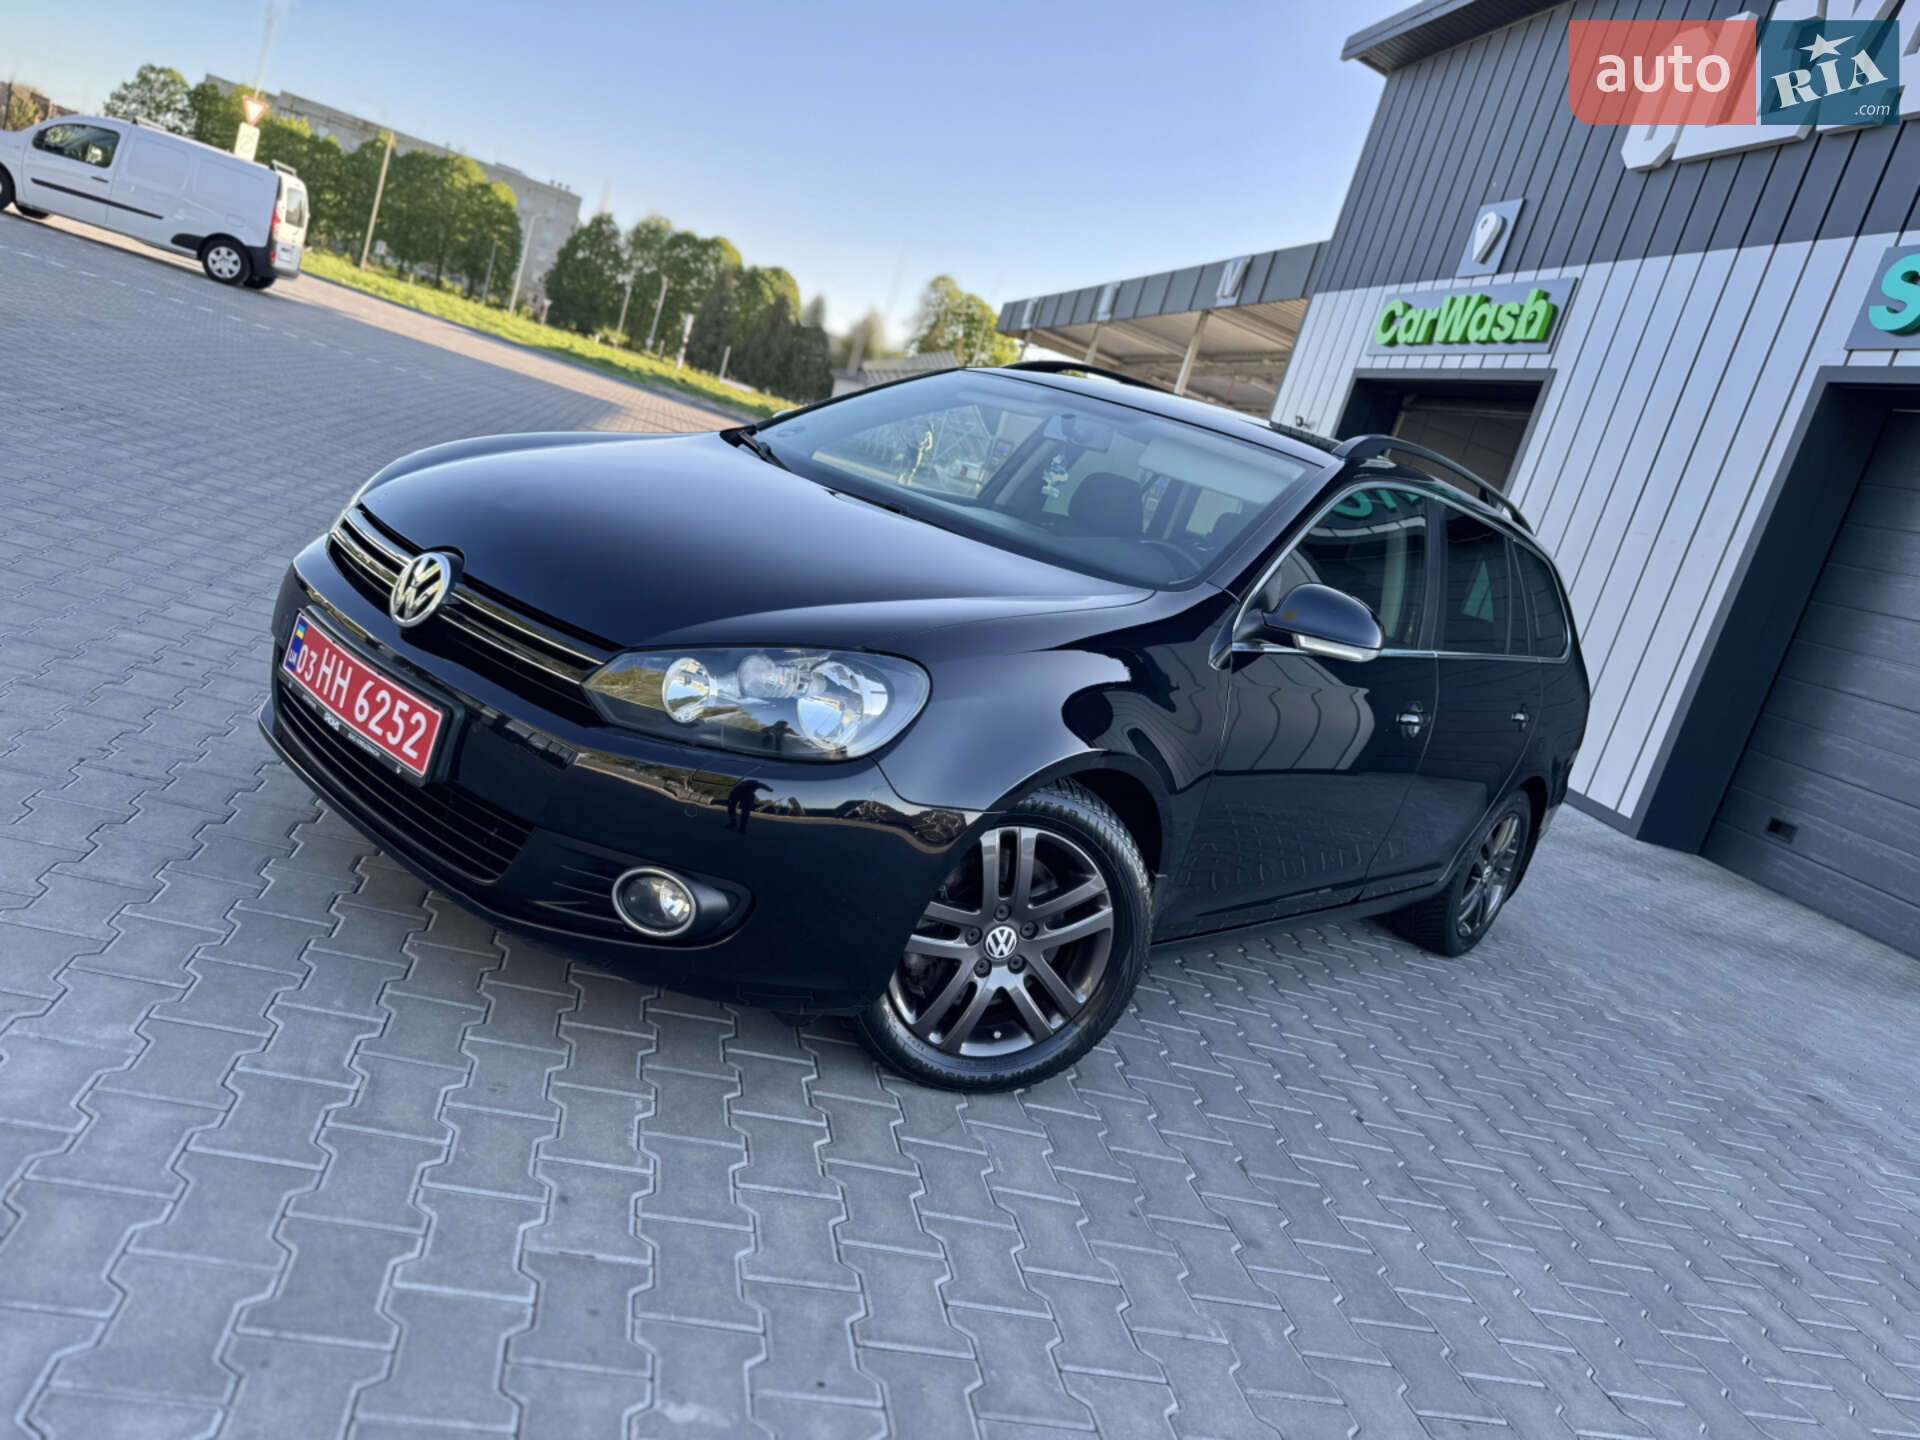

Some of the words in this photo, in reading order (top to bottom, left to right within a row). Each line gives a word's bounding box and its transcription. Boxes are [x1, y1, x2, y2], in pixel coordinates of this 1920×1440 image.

[1375, 288, 1556, 346] CarWash
[296, 644, 318, 682] 03
[315, 647, 353, 709] HH
[354, 680, 427, 760] 6252
[986, 926, 1017, 958] VW
